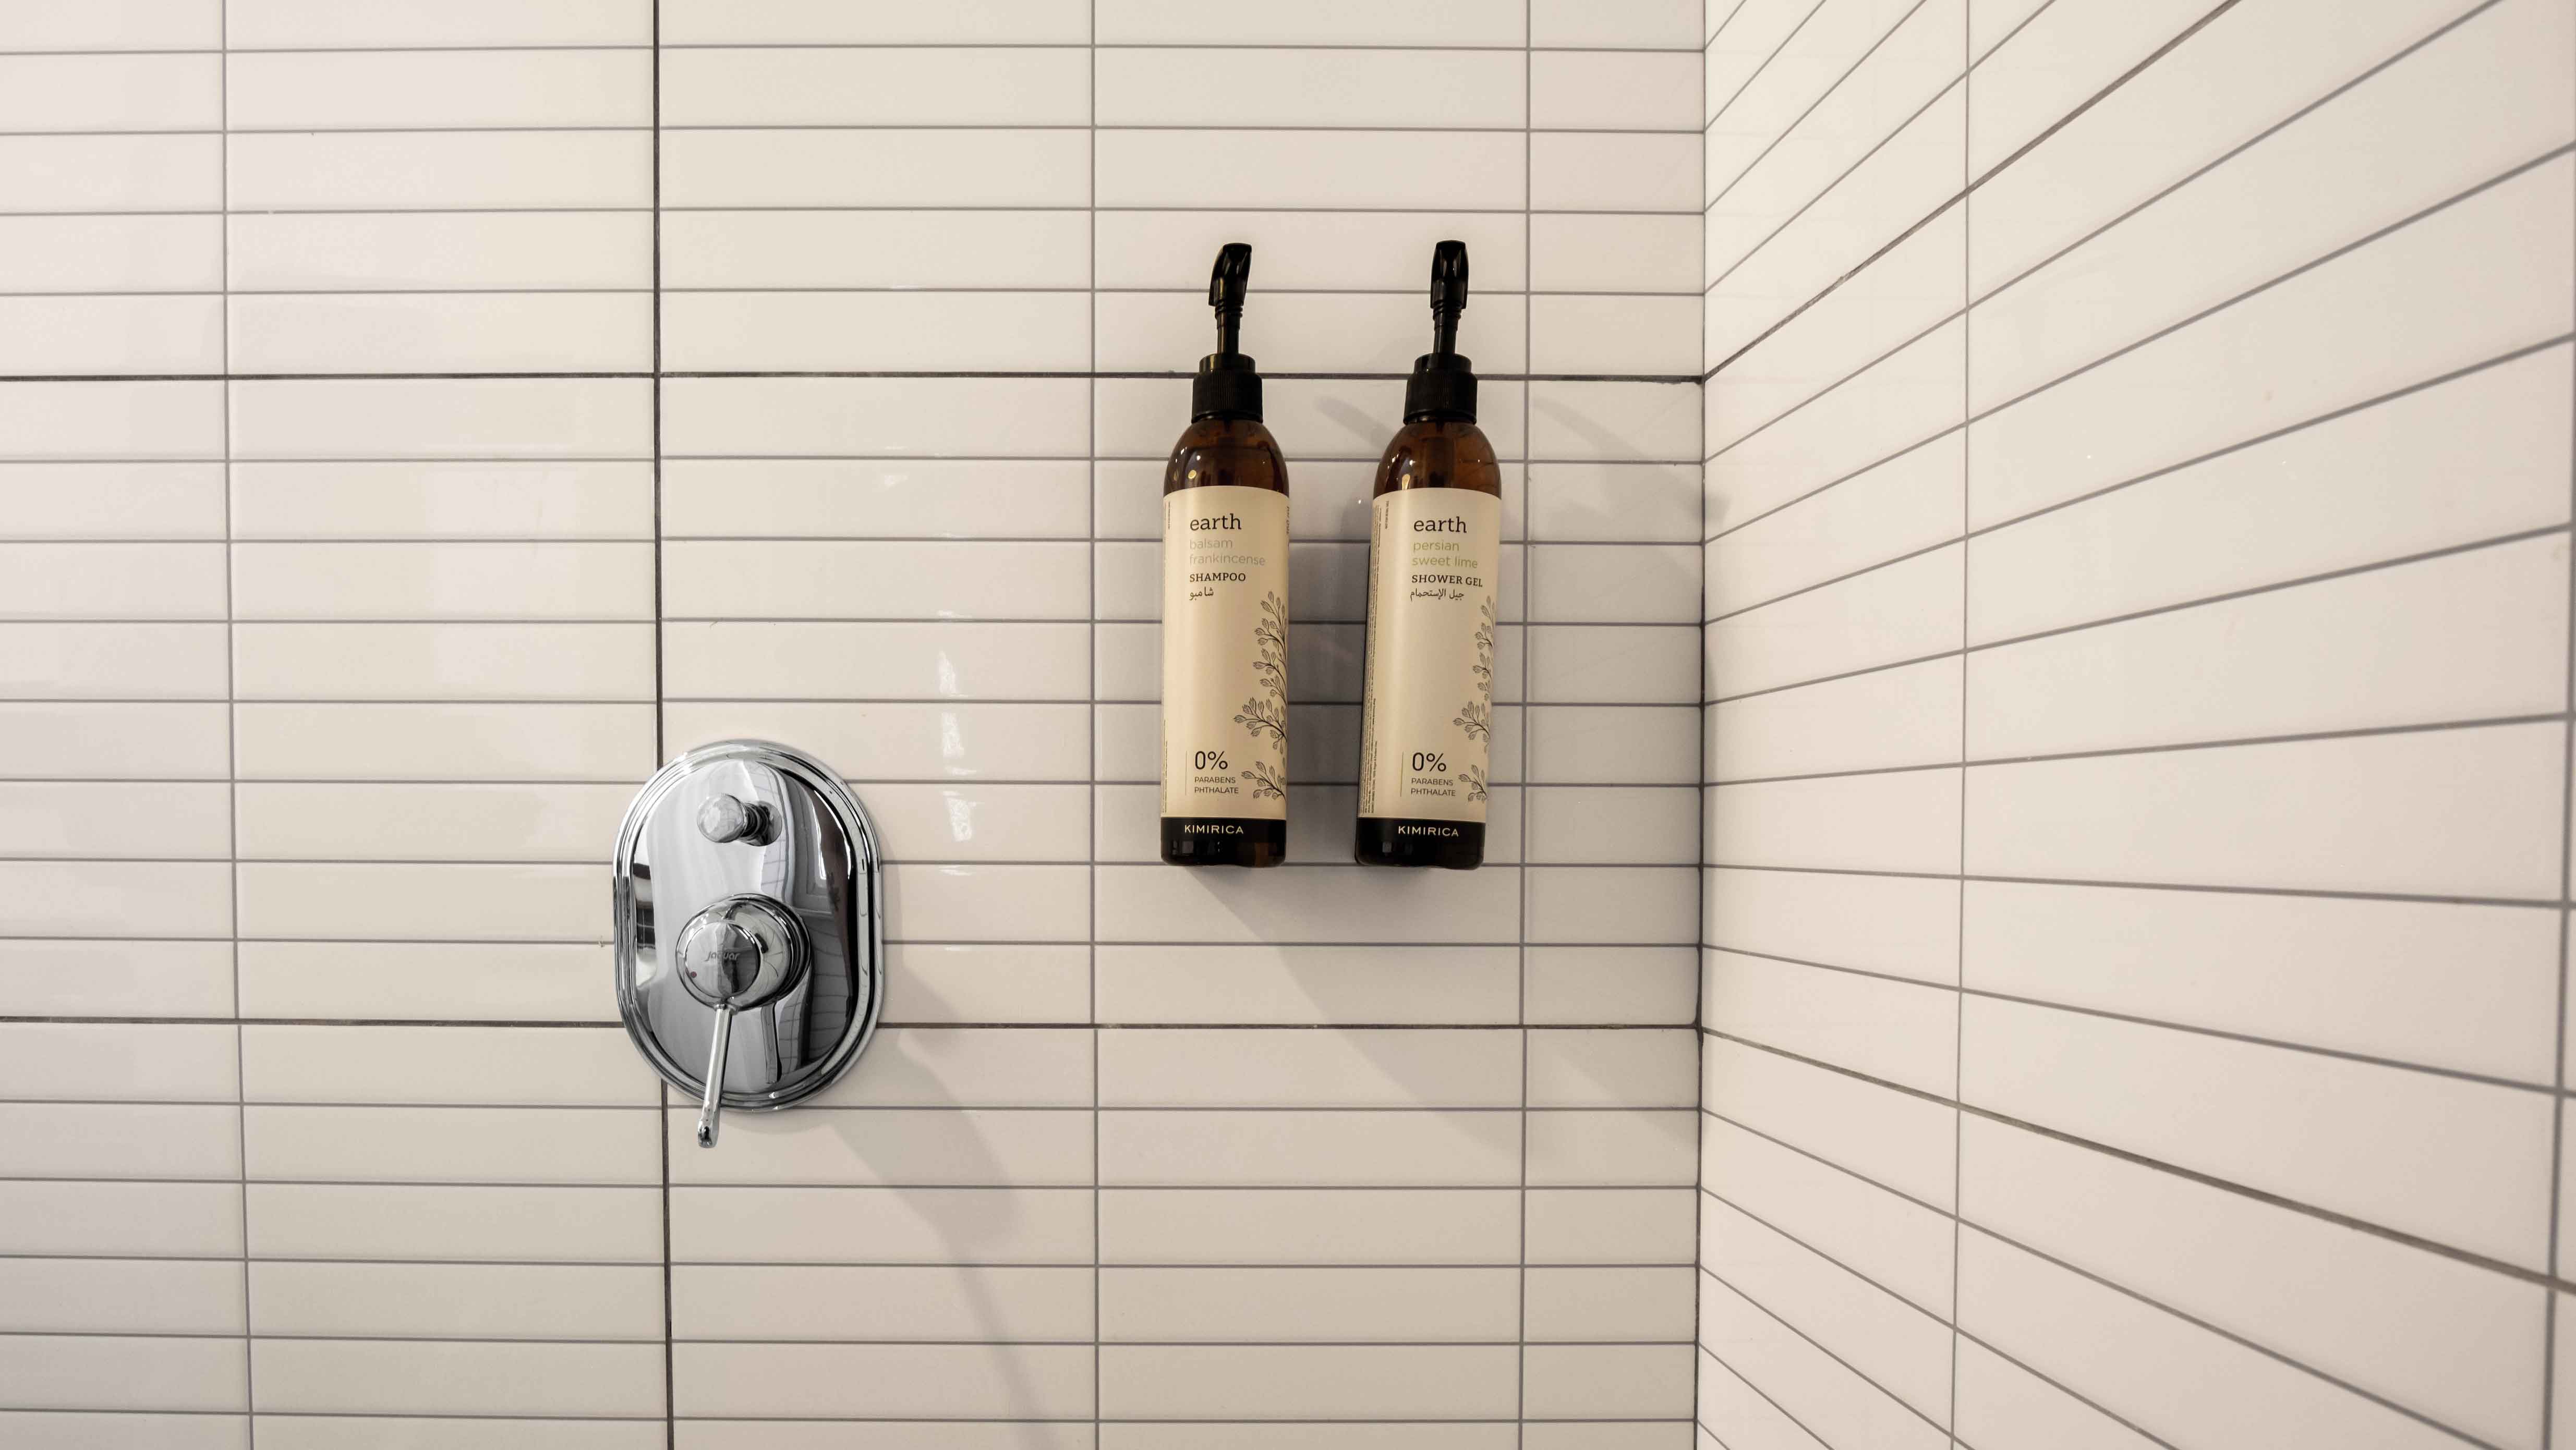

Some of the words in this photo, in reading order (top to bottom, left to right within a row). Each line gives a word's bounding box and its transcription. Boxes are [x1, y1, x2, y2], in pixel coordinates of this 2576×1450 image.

[1190, 513, 1242, 531] earth
[1413, 516, 1467, 533] earth
[1190, 538, 1233, 550] balsam
[1413, 540, 1459, 553] persian
[1189, 553, 1266, 566] frankincense
[1412, 555, 1453, 566] sweet
[1454, 557, 1478, 569] lime
[1189, 572, 1246, 582] SHAMPOO
[1411, 575, 1462, 584] SHOWER
[1465, 576, 1483, 587] GEL
[1449, 589, 1465, 601] جيل
[1194, 751, 1228, 770] 0%
[1412, 752, 1447, 772] 0%
[1411, 777, 1454, 786] PARABENS
[1410, 788, 1456, 797] PHTHALATE
[1184, 824, 1244, 835] KIMIRICA
[1398, 825, 1459, 837] KIMIRICA
